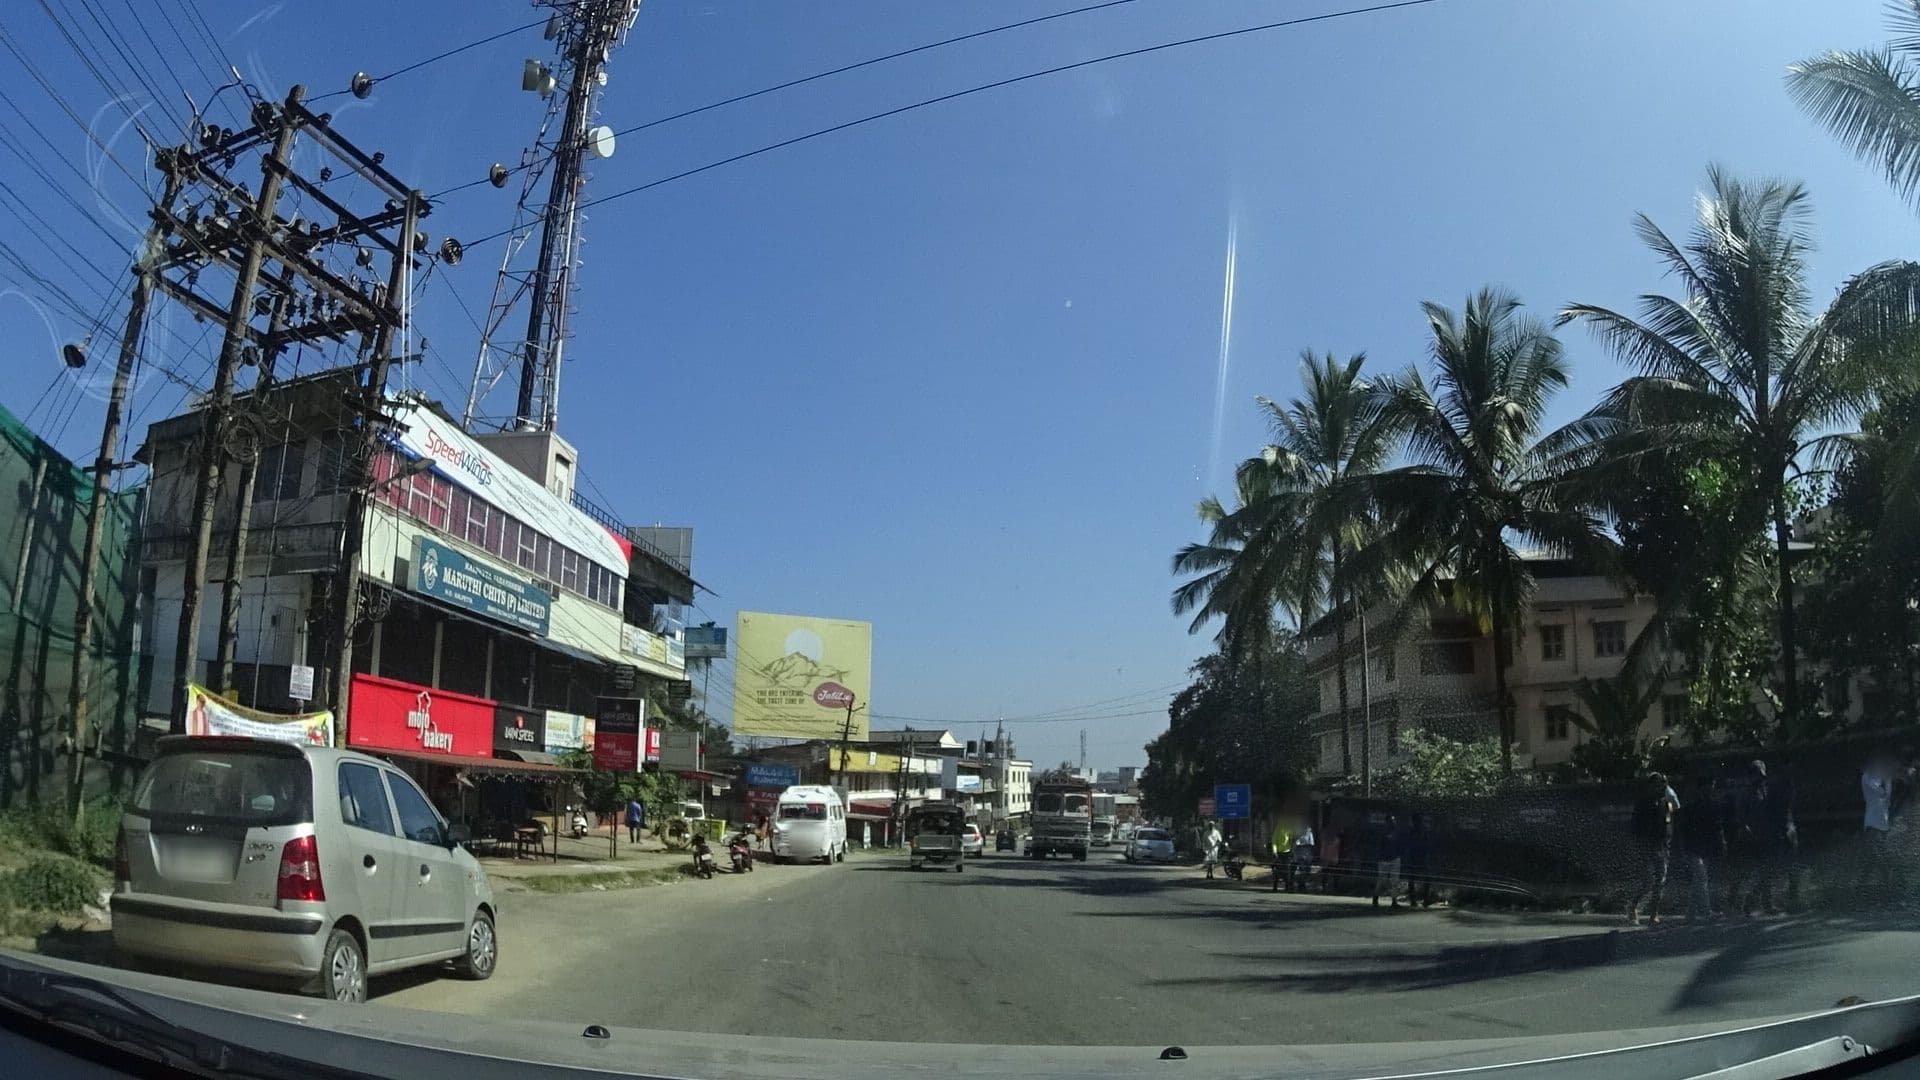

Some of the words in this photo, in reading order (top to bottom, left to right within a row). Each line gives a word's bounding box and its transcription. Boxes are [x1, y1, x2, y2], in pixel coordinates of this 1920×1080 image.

[425, 429, 493, 486] SpeedWings
[442, 567, 482, 596] MARUTHI
[482, 584, 507, 606] CHITS
[408, 709, 430, 740] mojo
[423, 721, 453, 752] bakery
